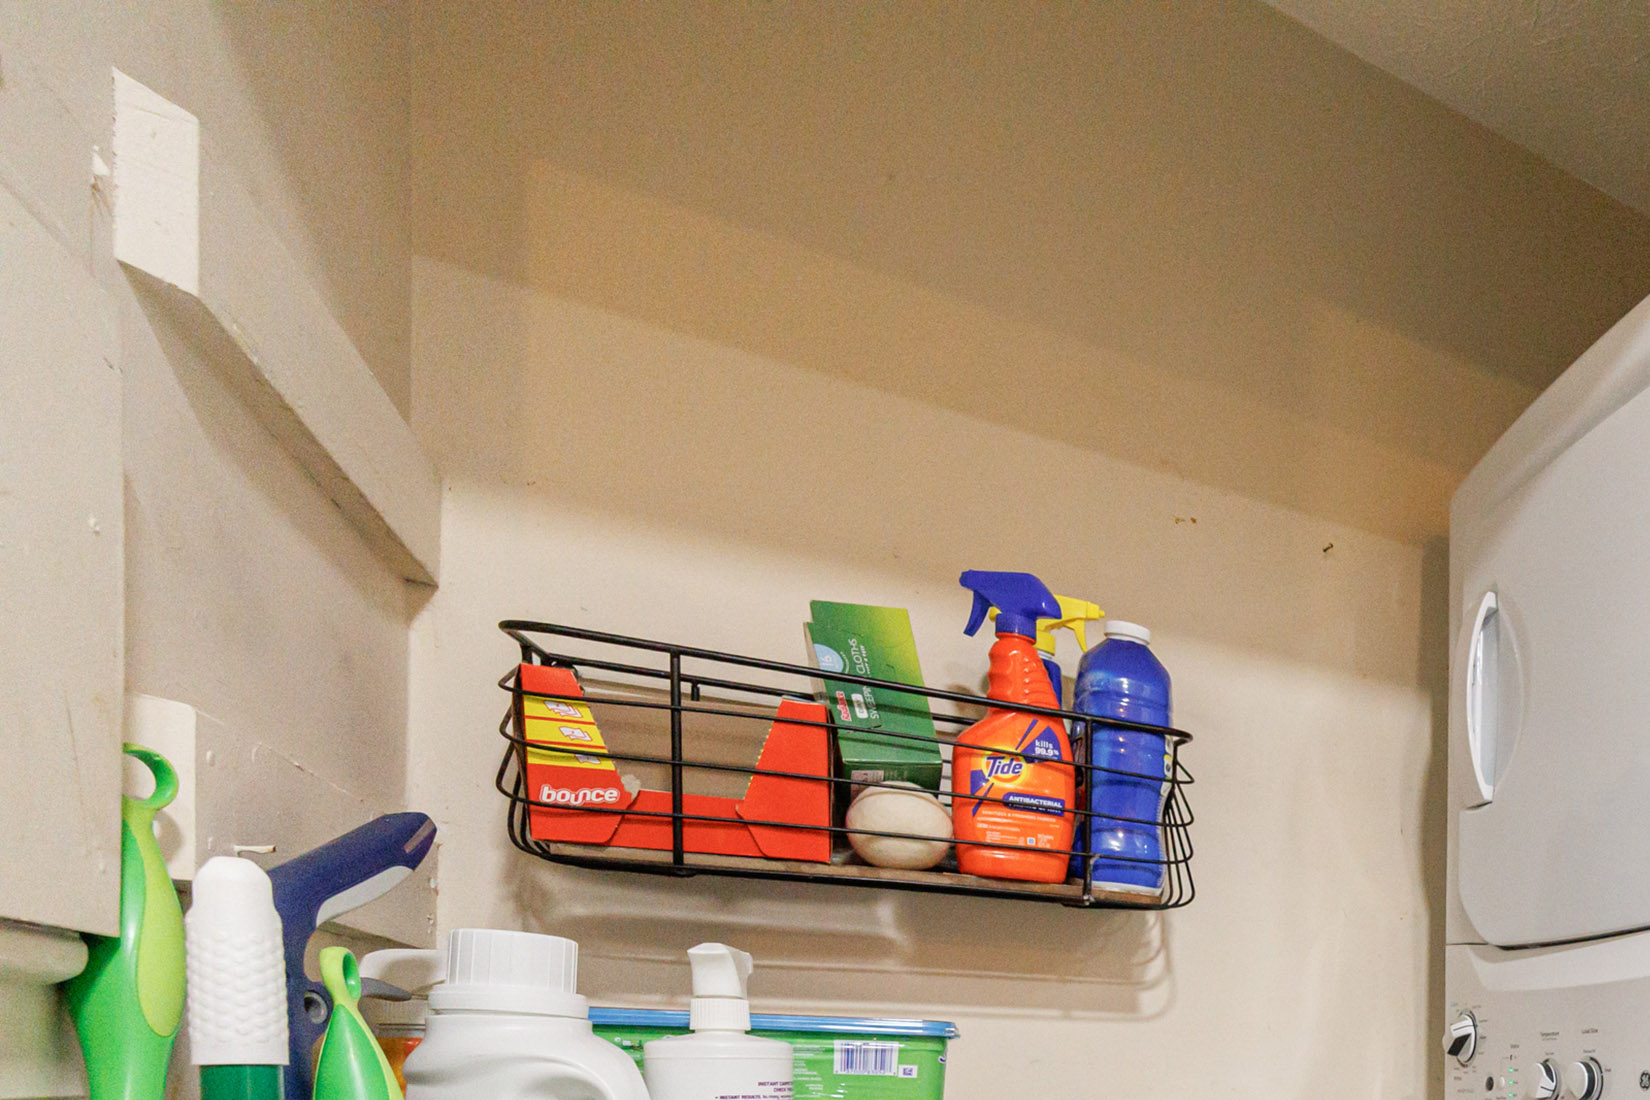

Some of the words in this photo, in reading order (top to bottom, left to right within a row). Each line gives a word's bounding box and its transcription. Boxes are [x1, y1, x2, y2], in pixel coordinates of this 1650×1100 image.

[848, 638, 865, 674] CLOTHS
[1035, 739, 1053, 749] kills
[985, 755, 1024, 779] Tide
[541, 785, 619, 806] bounce
